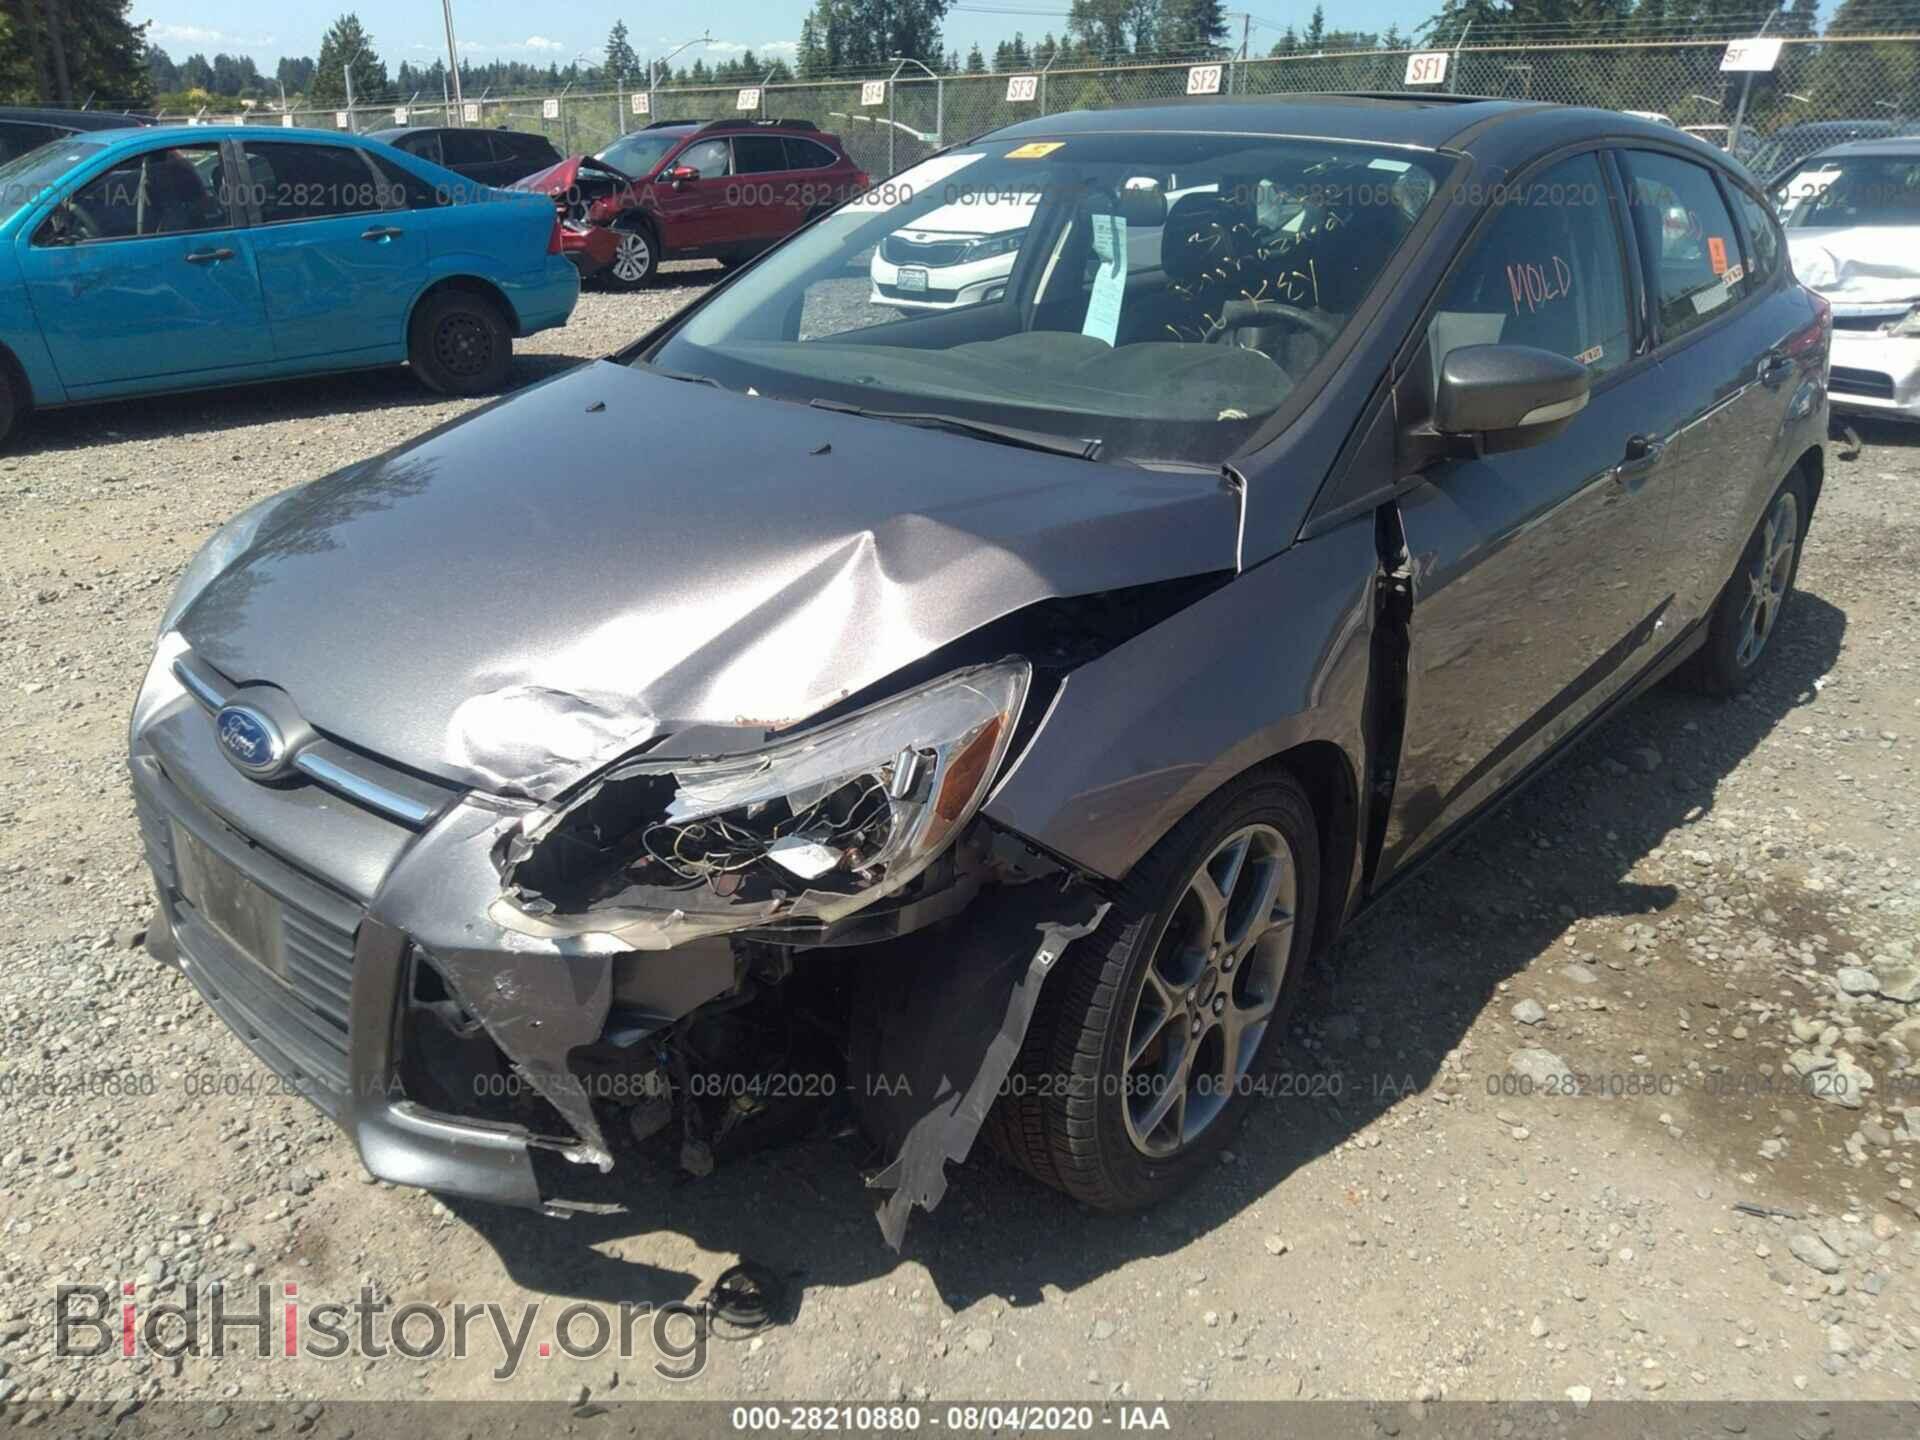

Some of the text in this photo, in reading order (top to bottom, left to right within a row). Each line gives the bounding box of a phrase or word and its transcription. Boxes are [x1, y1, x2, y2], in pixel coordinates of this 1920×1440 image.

[1190, 68, 1218, 91] SF2
[1411, 56, 1441, 82] SF1
[1009, 78, 1035, 99] SF3
[1506, 255, 1572, 317] MOLD
[222, 714, 263, 758] Ford
